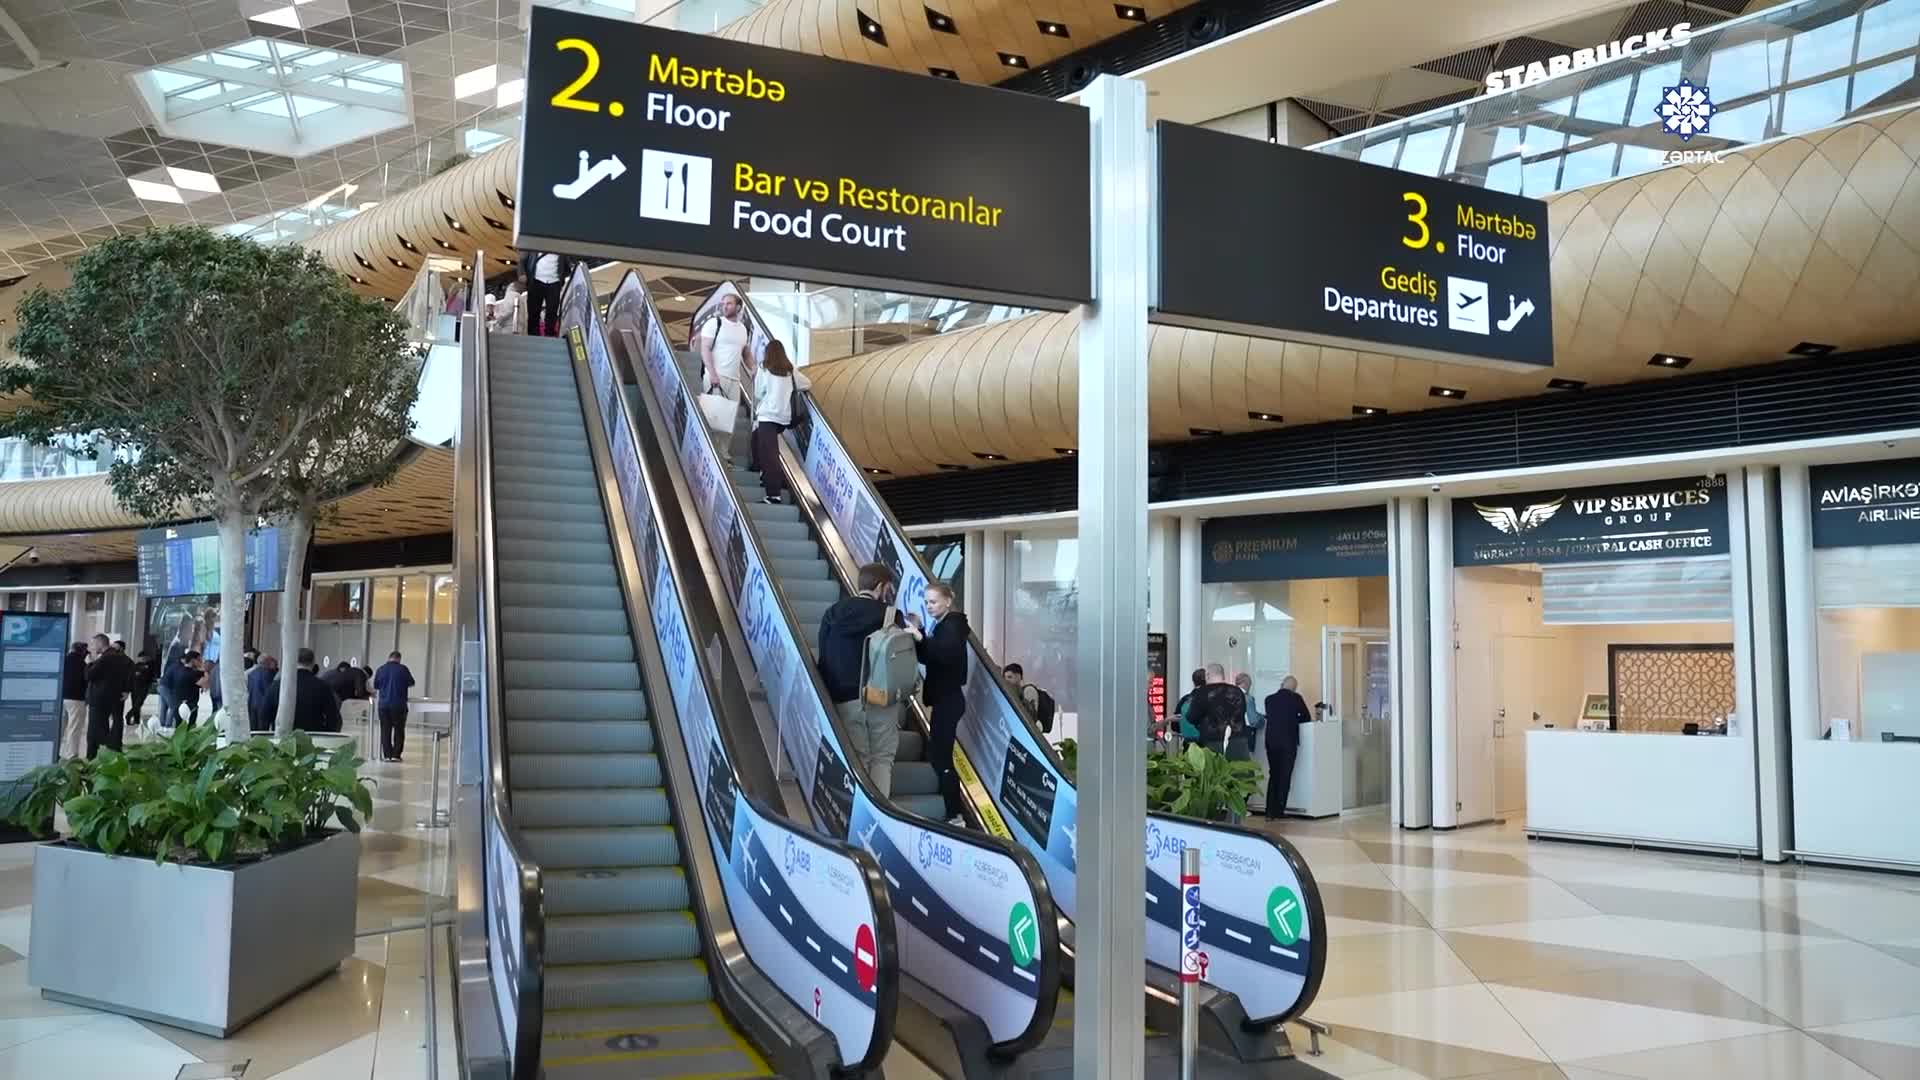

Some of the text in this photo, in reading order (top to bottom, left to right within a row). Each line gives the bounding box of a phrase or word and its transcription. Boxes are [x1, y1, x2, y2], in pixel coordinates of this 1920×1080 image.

[1486, 22, 1691, 95] STARBUCKS
[551, 38, 624, 118] 2.
[647, 54, 786, 103] Mərtəbə
[646, 93, 731, 132] Floor
[735, 163, 1002, 228] Bar və Restoranlar
[733, 201, 906, 251] Food Court
[1402, 192, 1445, 253] 3.
[1457, 204, 1536, 240] Mərtəbə
[1457, 234, 1506, 264] Floor
[1381, 265, 1438, 302] Gediş
[1324, 286, 1438, 327] Departures
[1572, 489, 1710, 515] VIP SERVICES
[1821, 482, 1920, 504] AVİAŞİRKƏ
[1604, 512, 1673, 525] GROUP
[1235, 537, 1298, 553] PREMIUM
[1629, 539, 1663, 551] CASH
[1665, 536, 1712, 549] OFFICE
[796, 849, 811, 872] ABB
[933, 843, 953, 865] ABB
